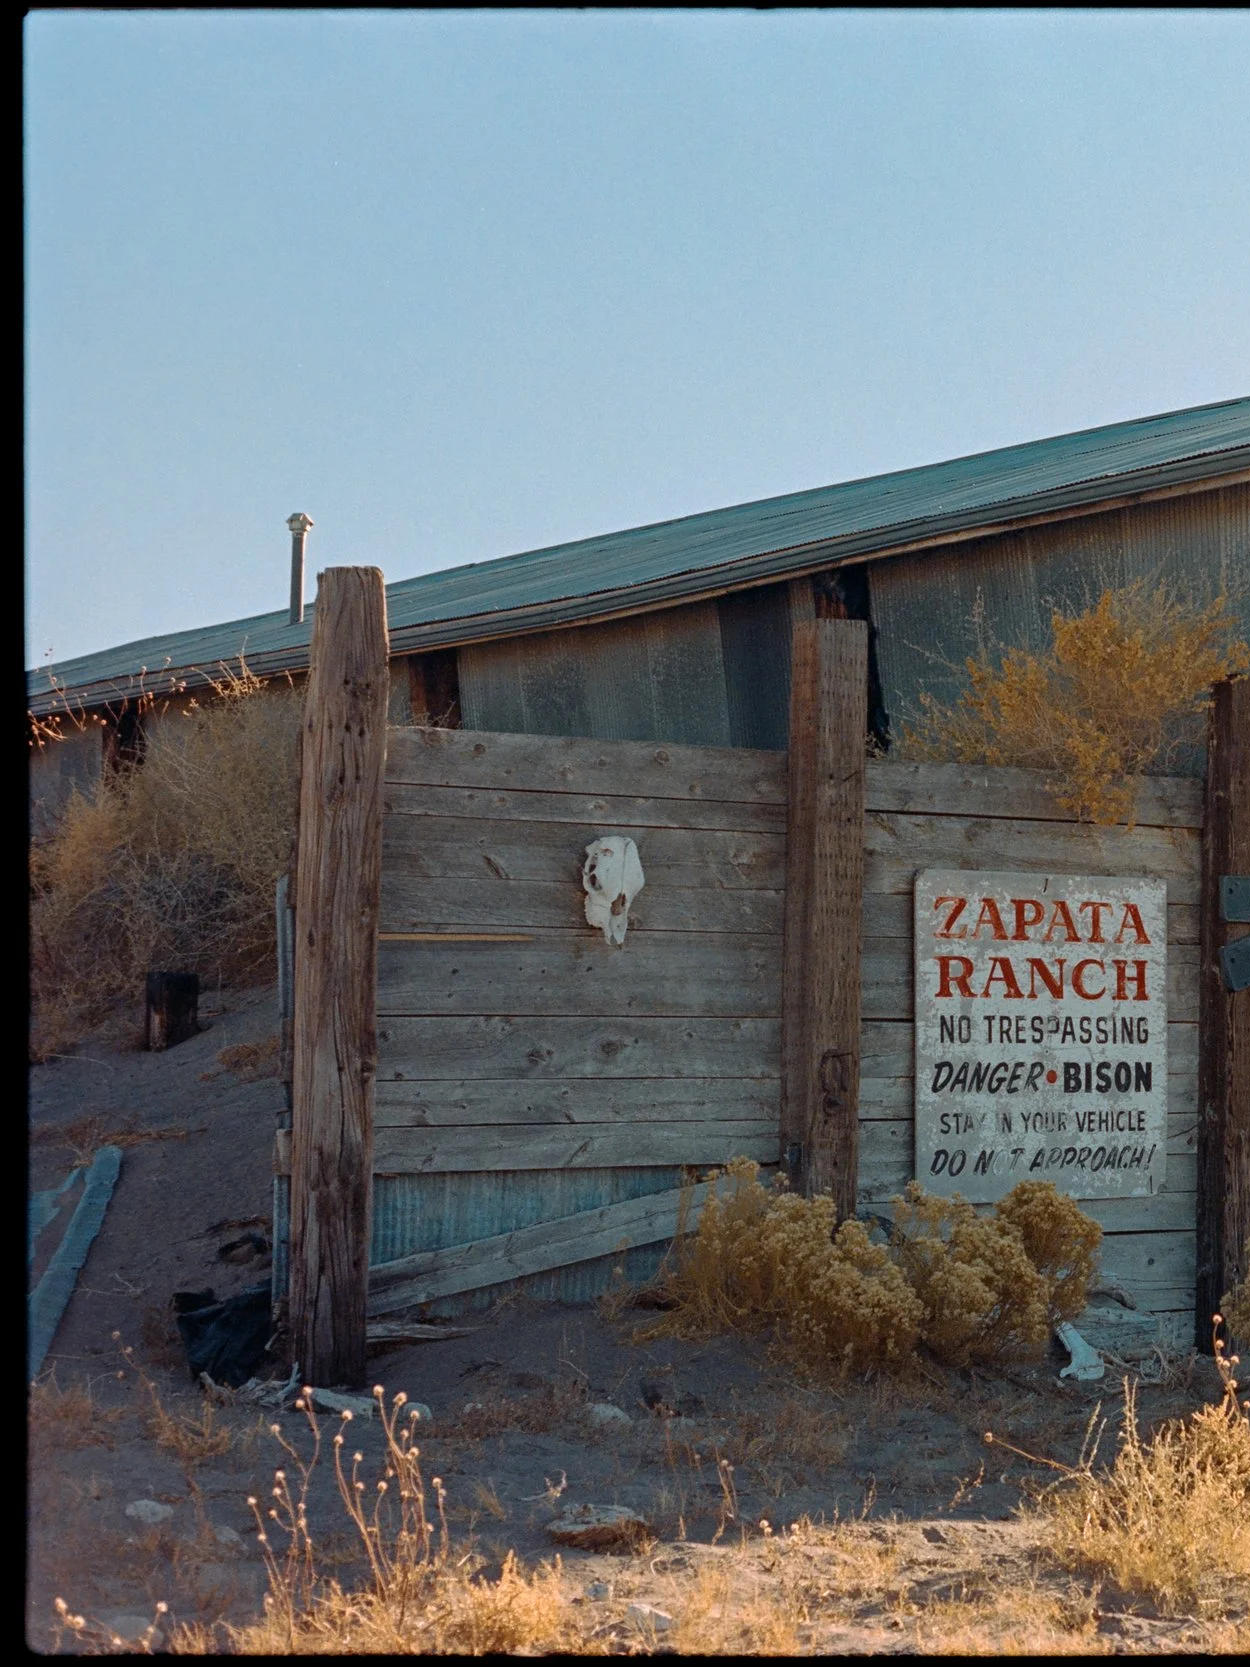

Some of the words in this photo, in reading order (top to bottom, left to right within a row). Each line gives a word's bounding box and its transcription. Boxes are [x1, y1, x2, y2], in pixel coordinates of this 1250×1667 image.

[933, 896, 1151, 944] ZAPATA
[934, 955, 1150, 1001] RANCH
[940, 1015, 972, 1044] NO
[984, 1015, 1149, 1045] TRESPASSING
[931, 1061, 1045, 1094] DANGER
[1063, 1061, 1152, 1093] BISON
[1021, 1111, 1067, 1134] YOUR
[1076, 1110, 1146, 1132] VEHICLE
[930, 1149, 967, 1176] DO
[1029, 1143, 1157, 1173] APPROACH!
